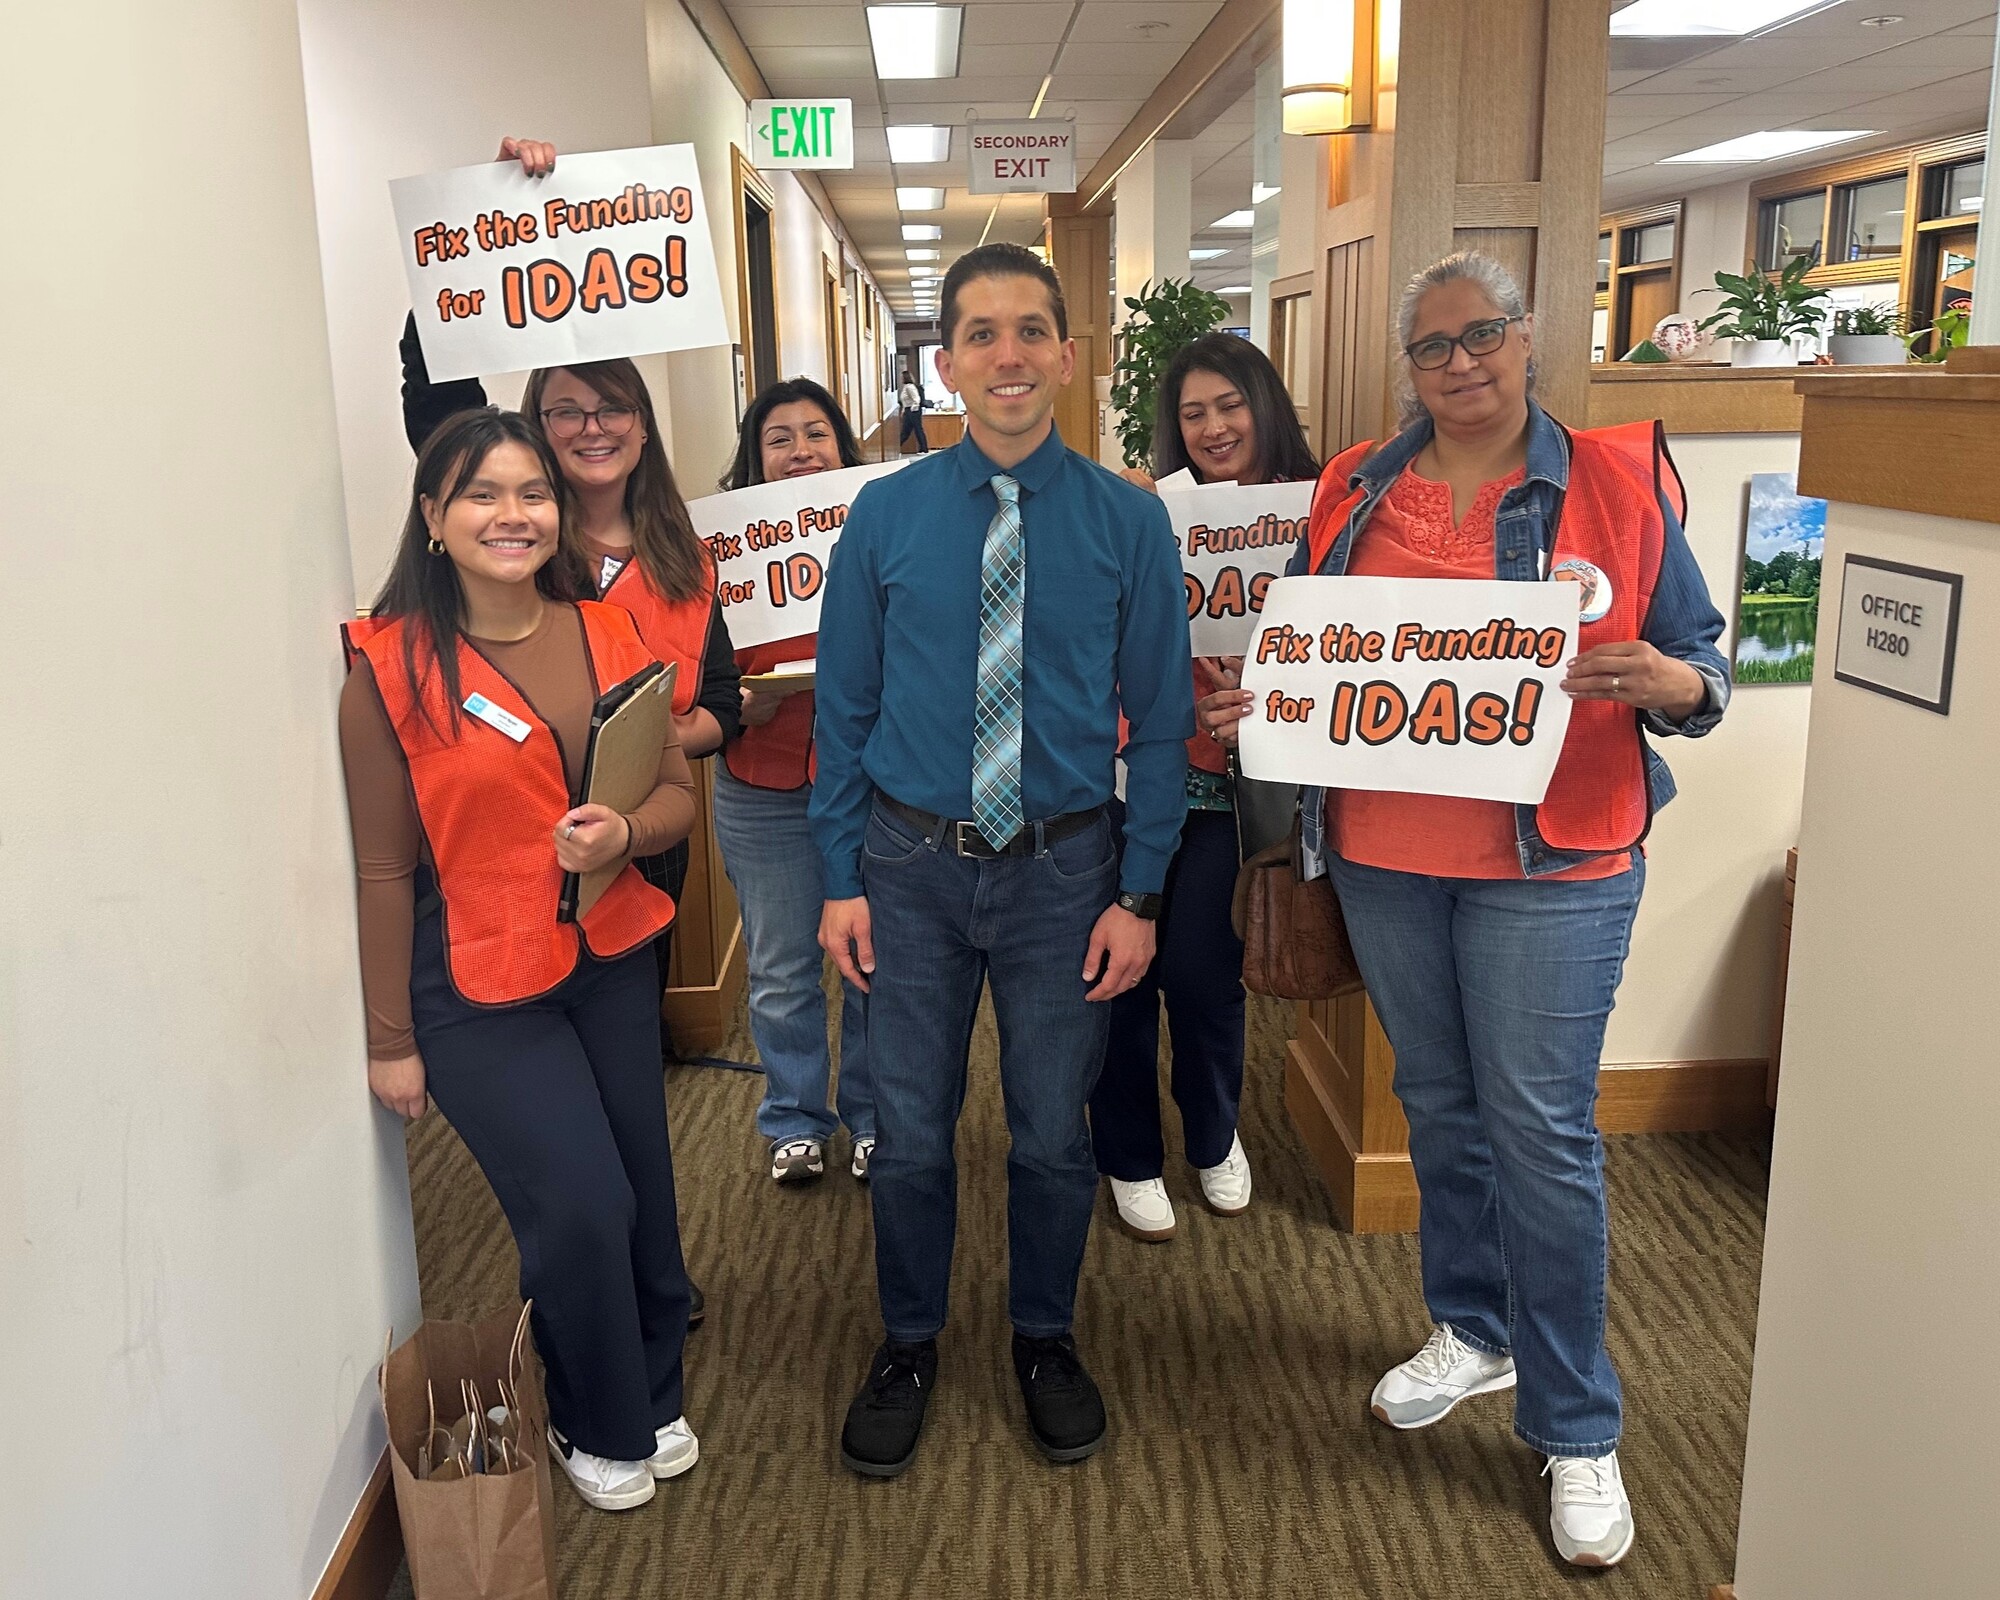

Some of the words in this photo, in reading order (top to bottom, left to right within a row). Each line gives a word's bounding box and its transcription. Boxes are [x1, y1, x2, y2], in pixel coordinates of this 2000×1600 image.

[770, 107, 836, 157] EXIT
[974, 135, 1069, 149] SECONDARY
[994, 158, 1050, 179] EXIT
[415, 221, 470, 266] Fix
[474, 210, 538, 251] the
[544, 183, 692, 238] Funding
[437, 288, 485, 322] for
[502, 235, 688, 328] IDAs!
[745, 519, 793, 552] the
[797, 503, 850, 537] Fun
[719, 580, 755, 607] for
[767, 552, 824, 608] ID
[1861, 593, 1923, 627] OFFICE
[1256, 624, 1314, 665] Fix
[1319, 622, 1385, 663] the
[1392, 618, 1566, 668] Funding
[1866, 627, 1909, 657] H280
[1266, 690, 1314, 723] for
[1329, 678, 1544, 746] IDAs!
